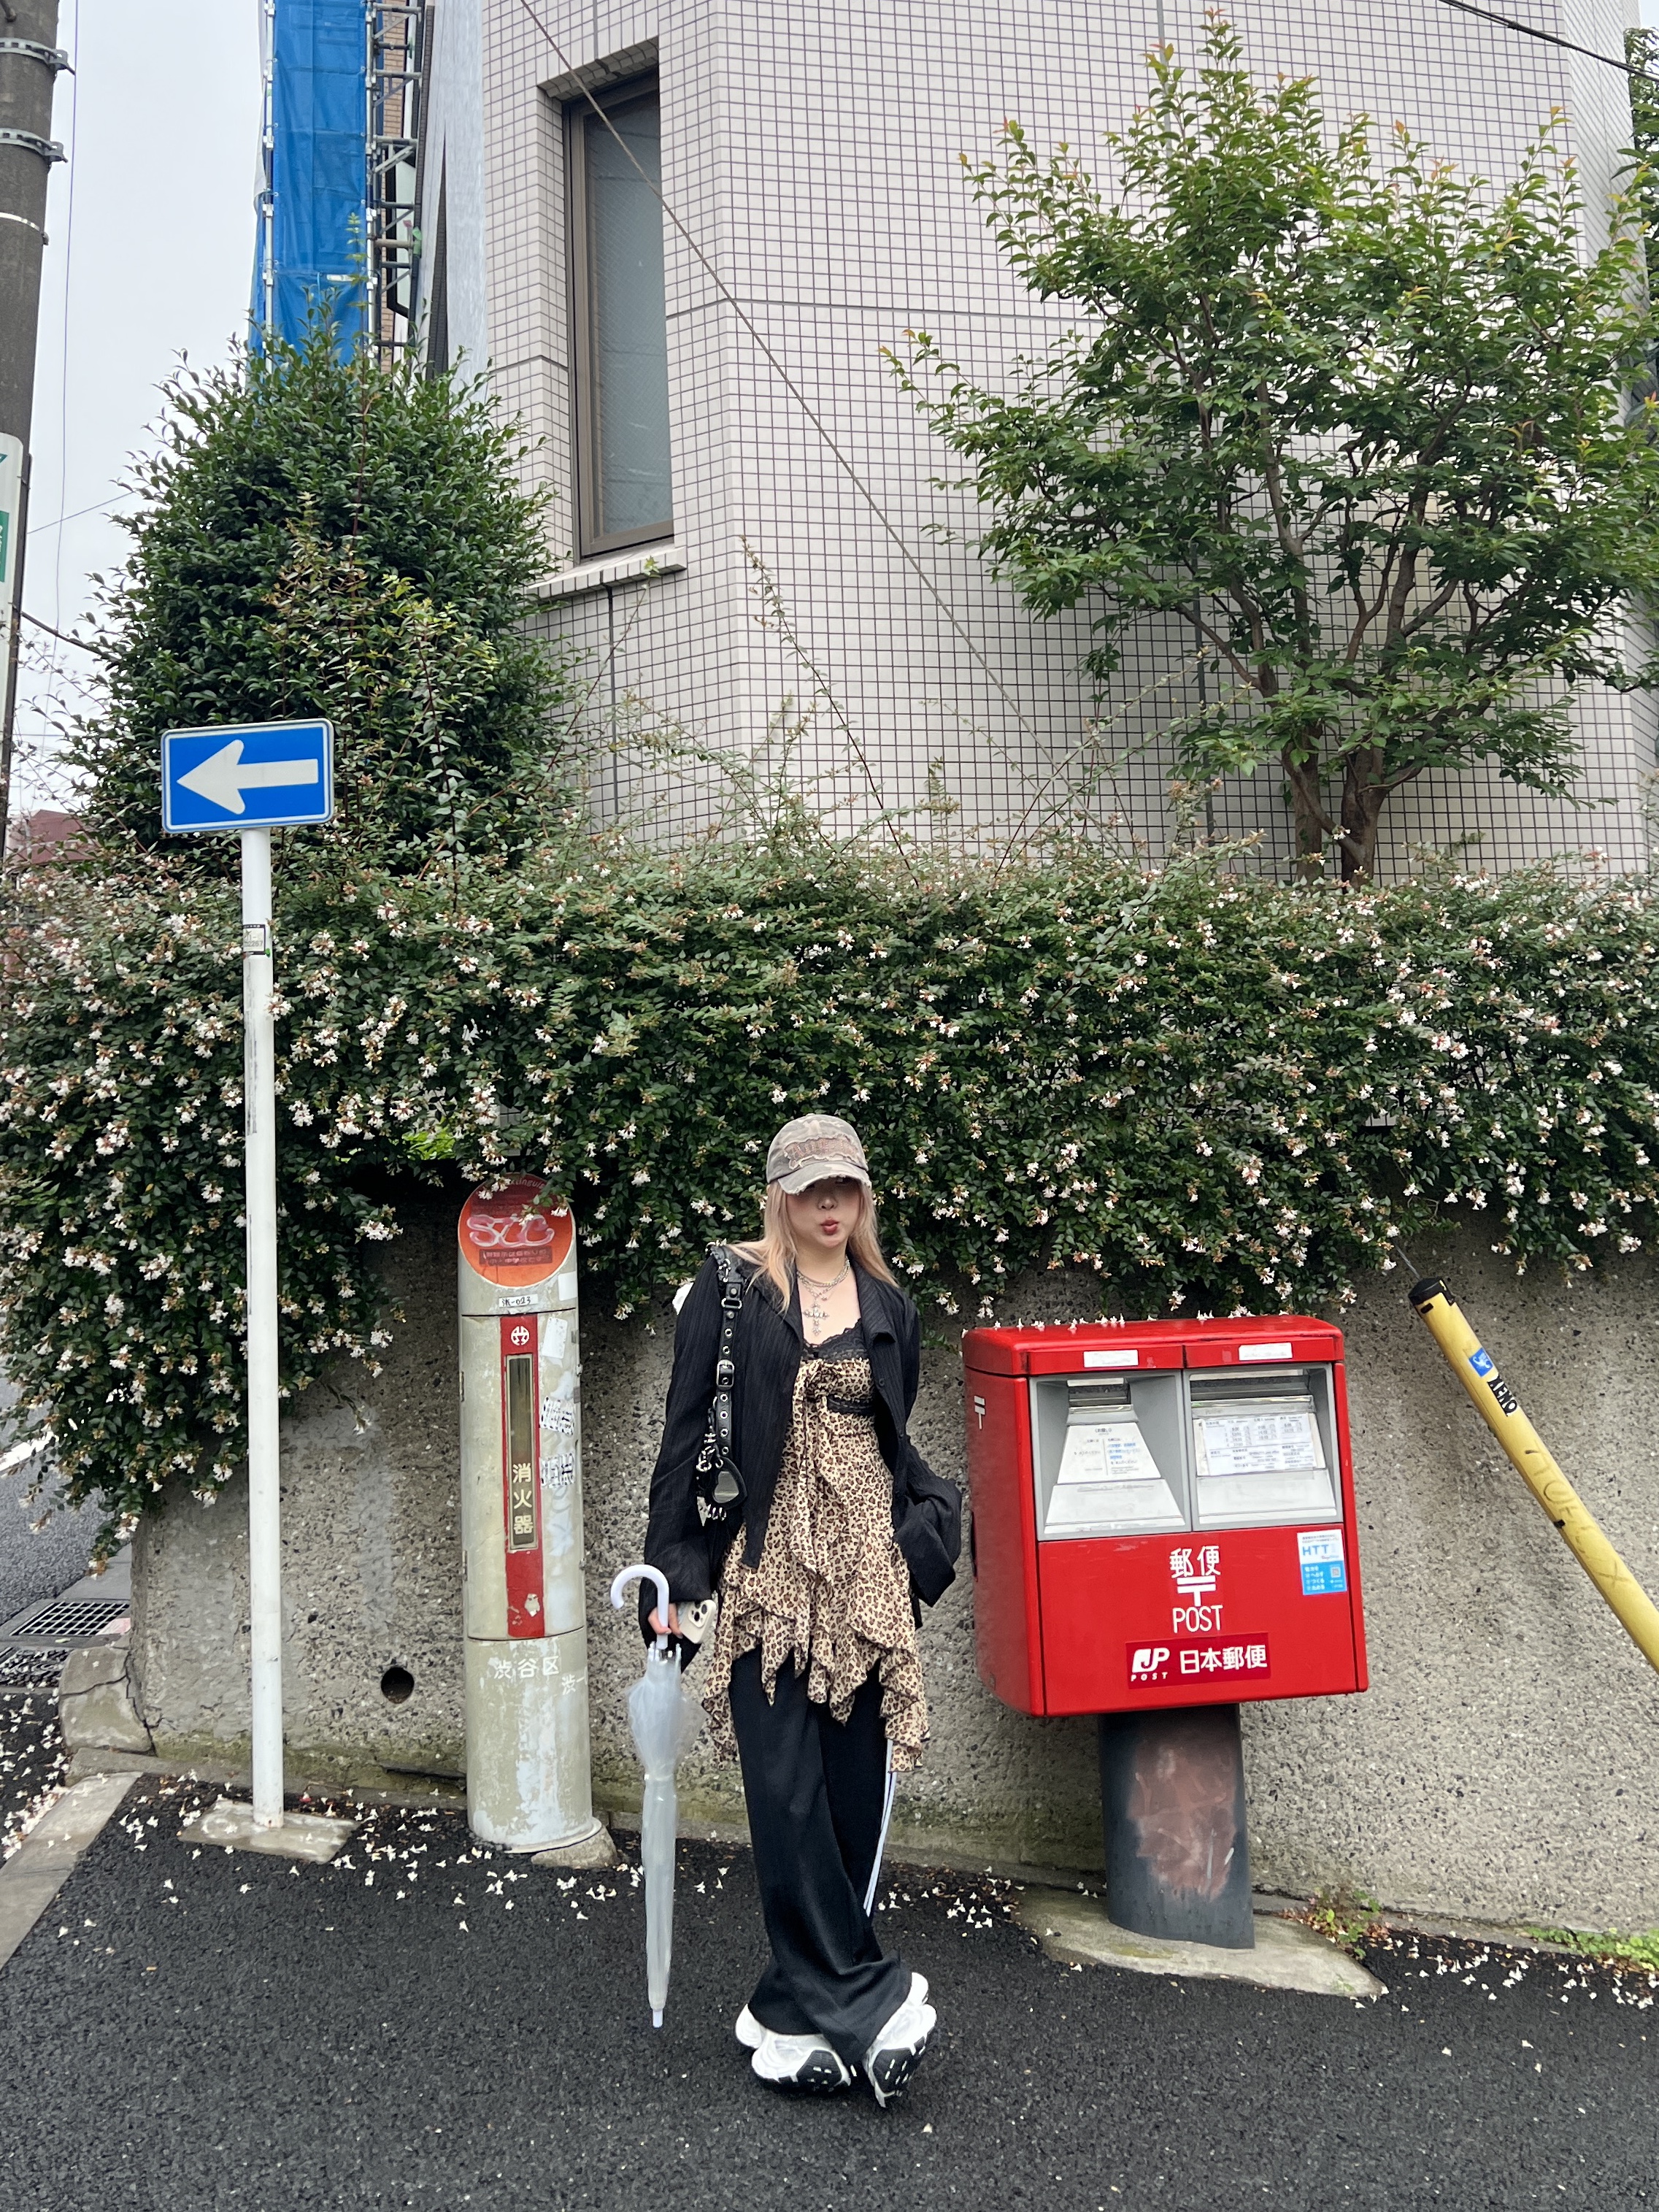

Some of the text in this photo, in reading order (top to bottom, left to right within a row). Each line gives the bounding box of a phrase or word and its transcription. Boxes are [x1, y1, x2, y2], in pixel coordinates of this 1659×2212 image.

[512, 1462, 534, 1535] 消火器
[1169, 1545, 1221, 1578] 郵便
[1172, 1605, 1223, 1633] POST
[493, 1655, 560, 1680] 渋谷区
[1132, 1648, 1170, 1673] JP
[1179, 1645, 1268, 1674] 日本郵便
[1131, 1672, 1168, 1681] POST
